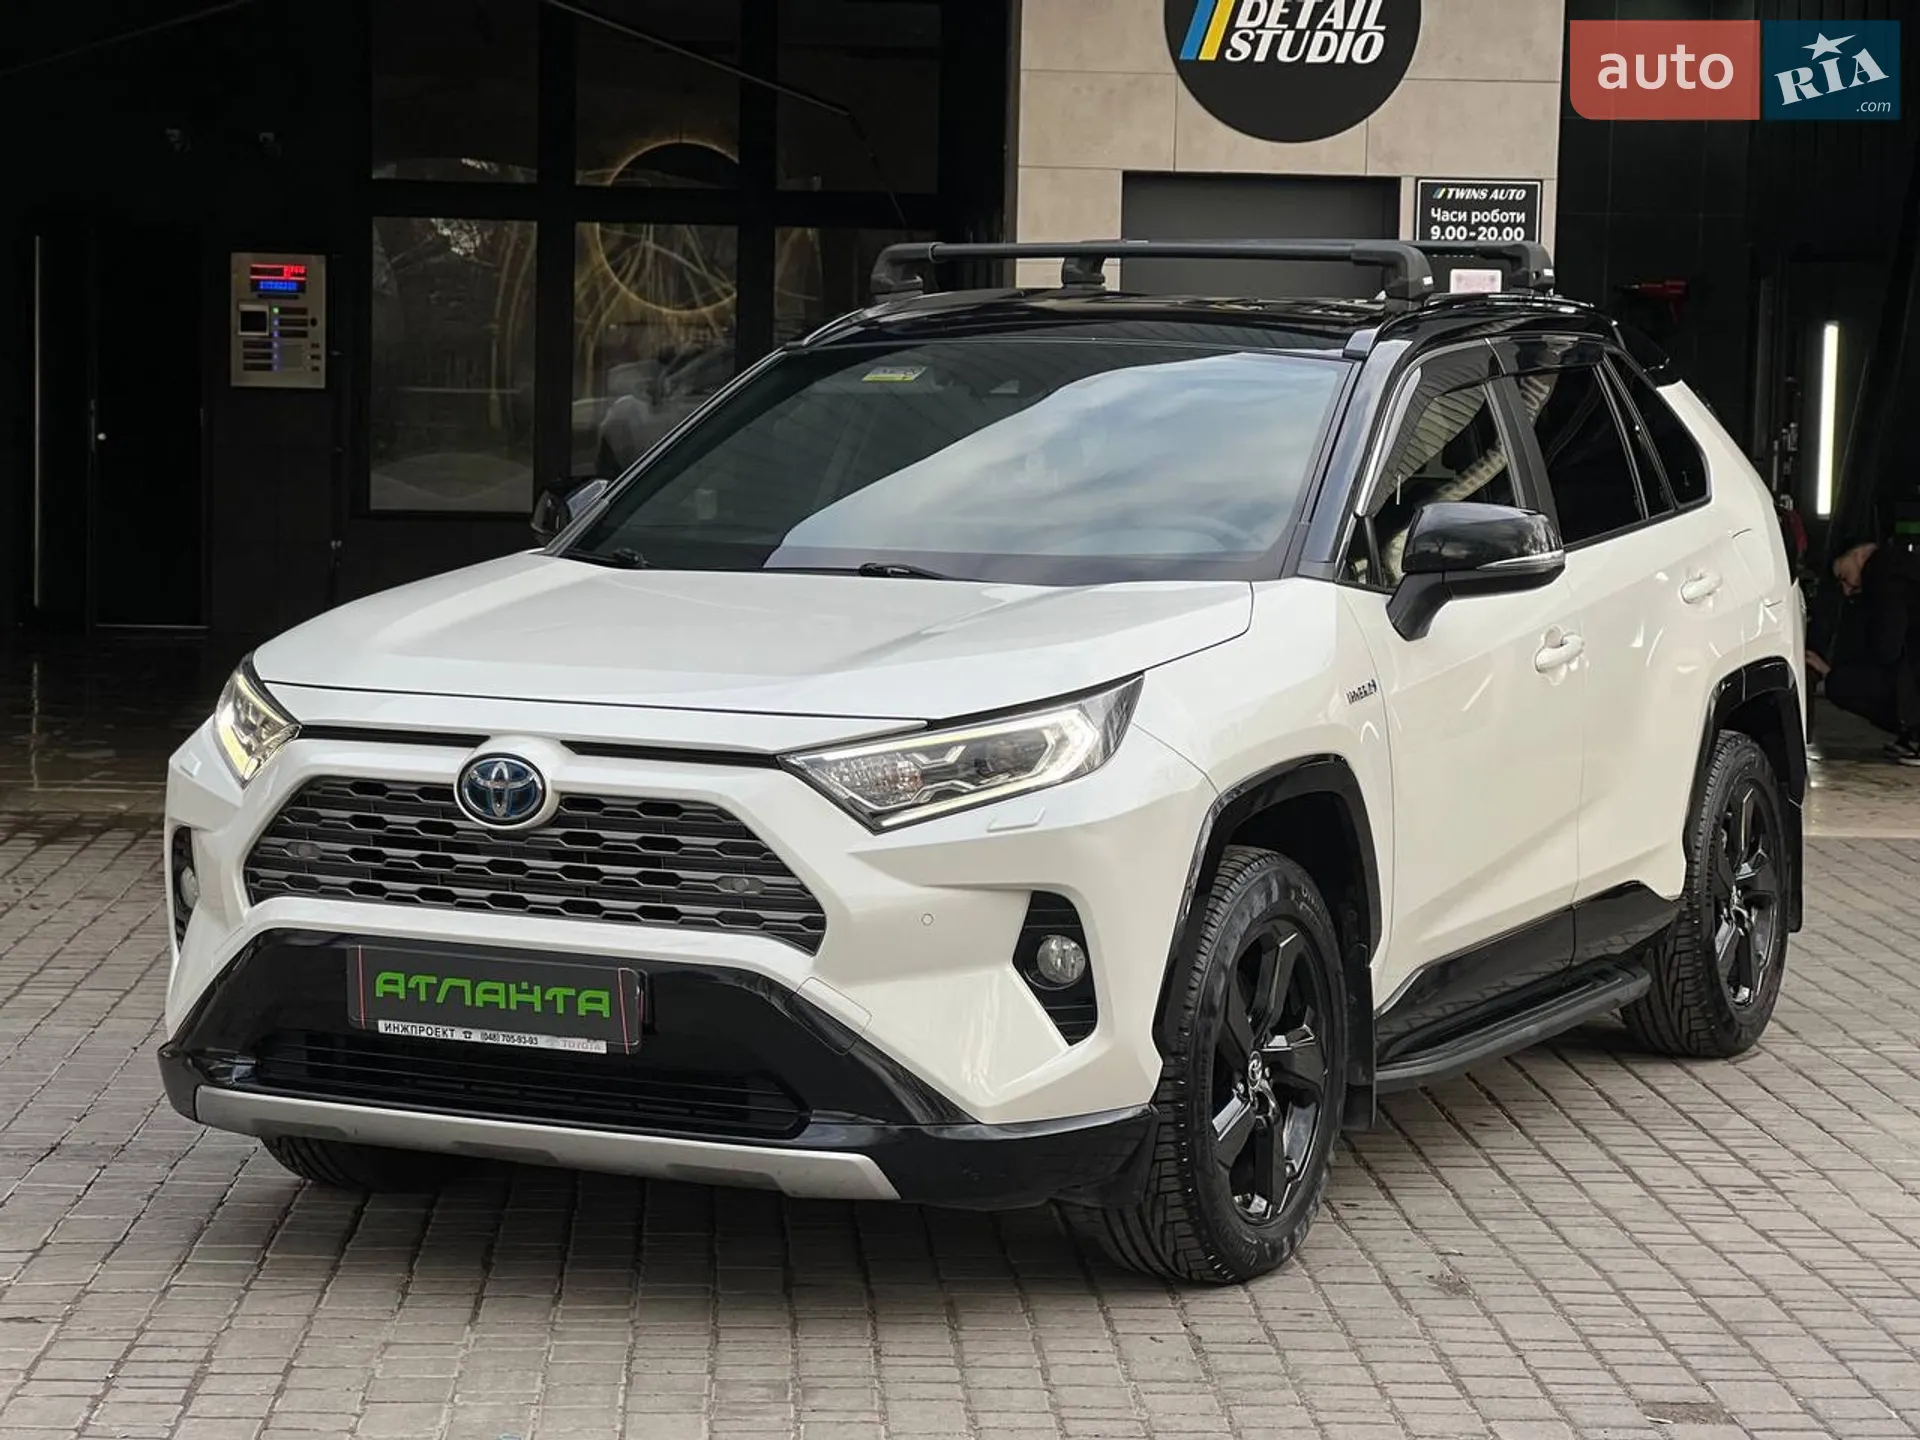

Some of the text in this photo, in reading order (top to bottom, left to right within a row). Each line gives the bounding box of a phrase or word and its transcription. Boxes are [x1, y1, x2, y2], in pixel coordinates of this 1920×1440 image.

[1235, 0, 1387, 30] DETAIL
[1225, 29, 1385, 64] STUDIO
[1447, 187, 1526, 200] TWINS AUTO
[1430, 207, 1526, 225] Часи роботи
[384, 1022, 456, 1038] ИНЖПРОЕКТ
